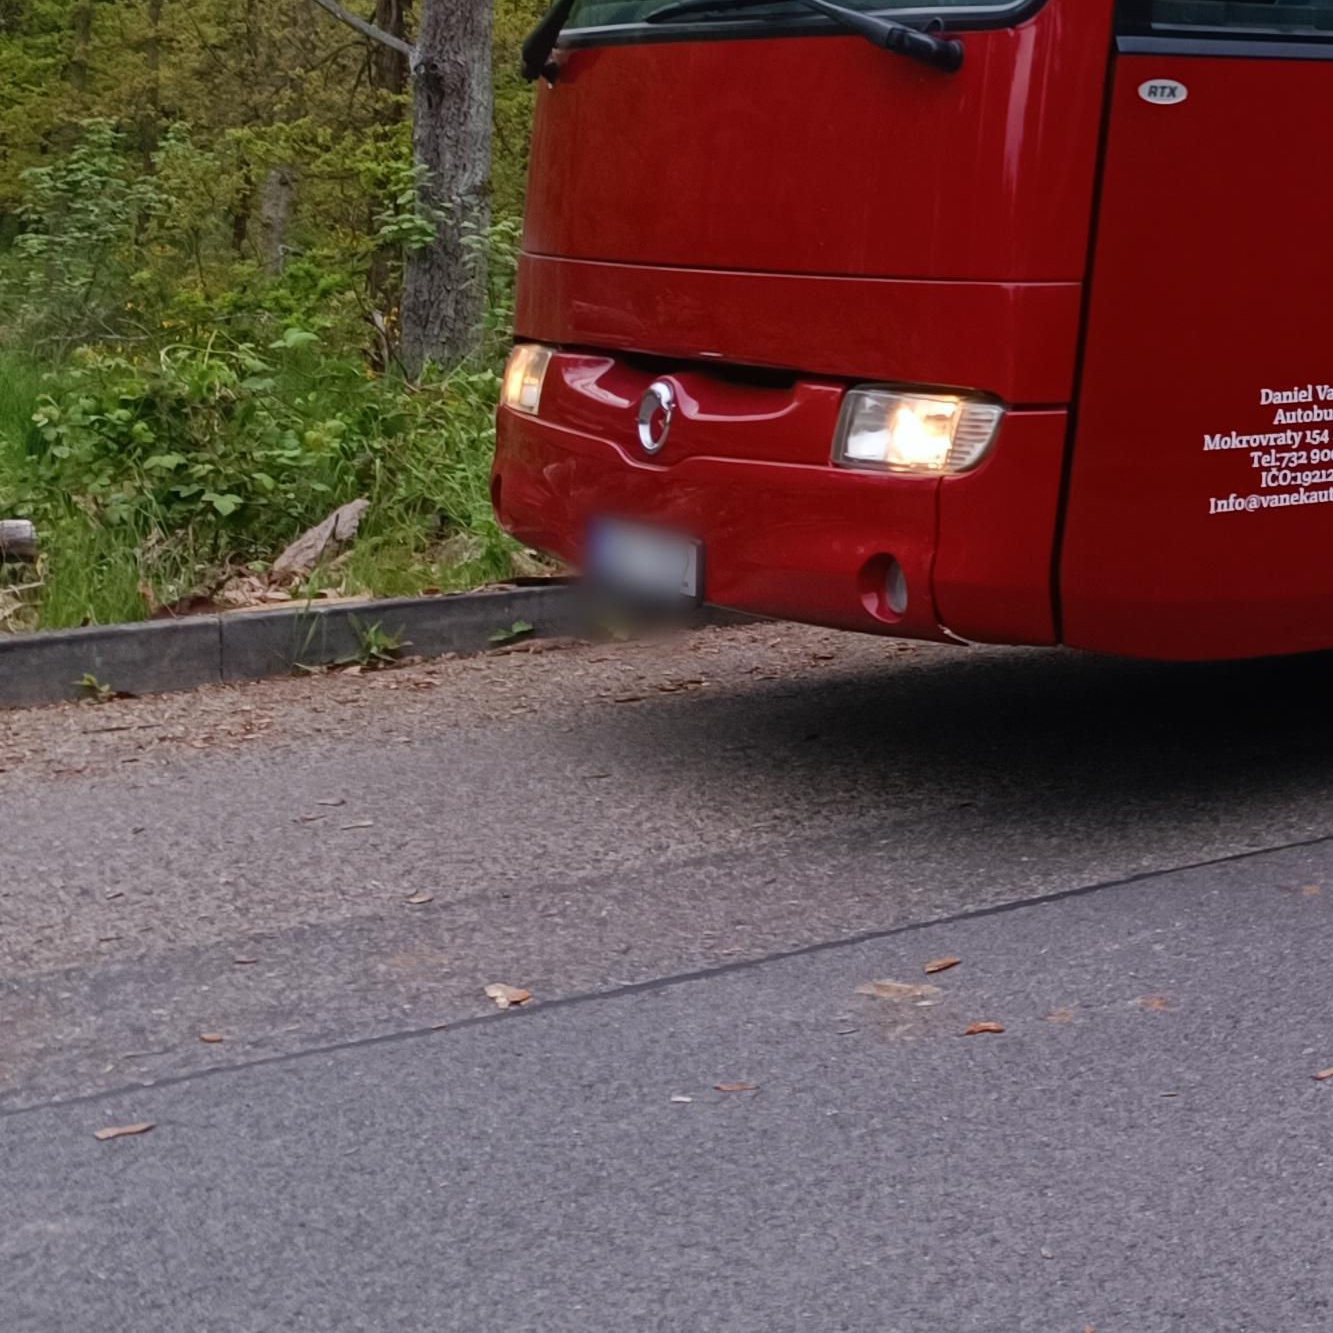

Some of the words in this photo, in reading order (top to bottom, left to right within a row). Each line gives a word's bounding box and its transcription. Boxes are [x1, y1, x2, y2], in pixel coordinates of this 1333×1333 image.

[1148, 85, 1178, 98] RTX
[1260, 384, 1313, 406] Daniel
[1203, 429, 1303, 451] Mokrovraty
[1305, 429, 1329, 444] 154
